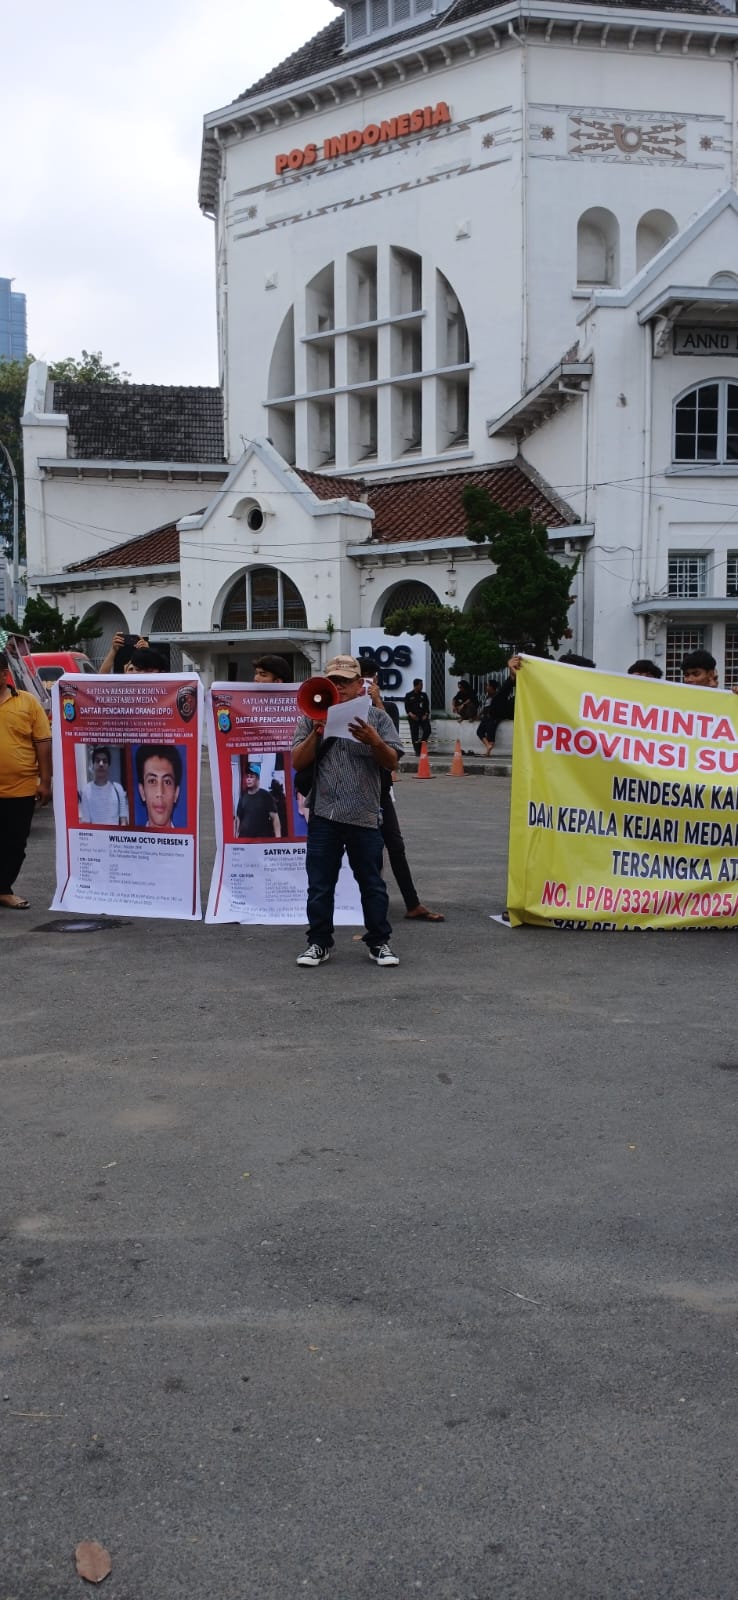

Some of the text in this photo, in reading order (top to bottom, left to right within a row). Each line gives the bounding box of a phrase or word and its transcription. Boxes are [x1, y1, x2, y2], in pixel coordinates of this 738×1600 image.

[275, 101, 451, 175] POS INDONESIA
[682, 332, 729, 349] ANNO
[80, 706, 101, 715] DAFTAR
[102, 706, 134, 715] PENCARIAN
[135, 706, 155, 715] ORANG
[242, 697, 269, 705] SATUAN
[251, 705, 297, 713] POLRESTABES
[235, 716, 258, 724] DAFTAR
[582, 694, 736, 742] MEMINTA
[535, 723, 738, 773] PROVINSI SU
[612, 776, 738, 810] MENDESAK KA
[557, 807, 617, 837] KEPALA
[623, 814, 679, 843] KEJARI
[109, 835, 137, 843] WILLYAM
[138, 836, 156, 845] OCTO
[157, 836, 183, 846] PIERSEN
[264, 848, 290, 856] SATRYA
[612, 850, 738, 881] TERSANGKA AT
[541, 880, 571, 907] NO.
